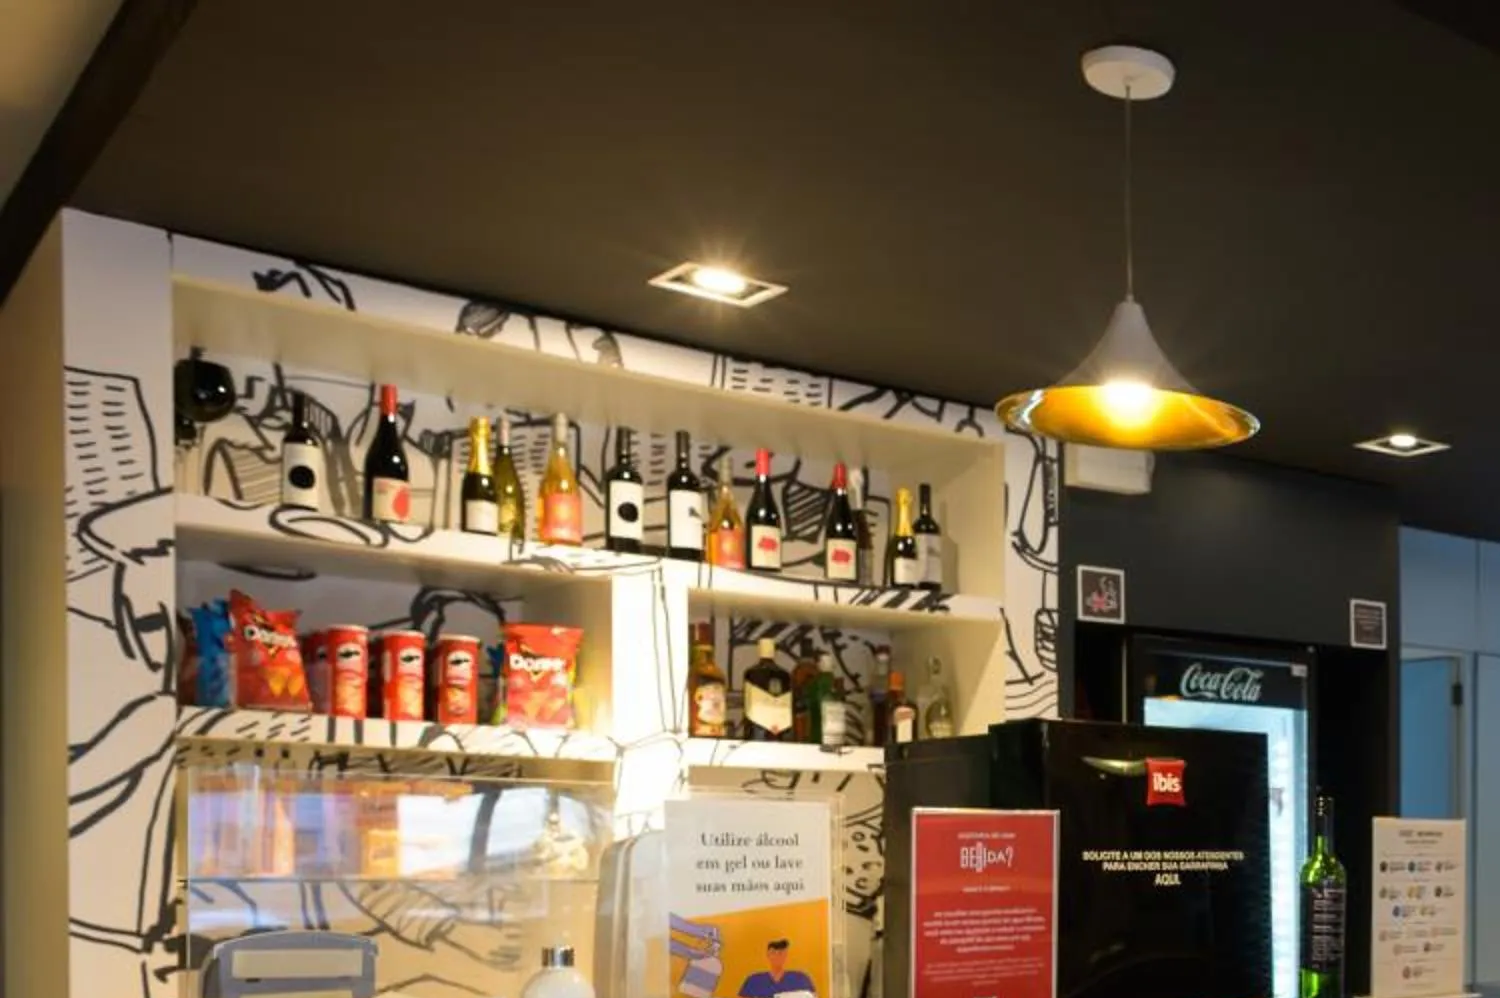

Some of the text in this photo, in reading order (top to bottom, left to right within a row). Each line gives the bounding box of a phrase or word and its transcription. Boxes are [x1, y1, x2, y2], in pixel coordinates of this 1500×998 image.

[1152, 771, 1182, 793] ibis
[700, 831, 800, 848] Utilize álcool
[696, 855, 804, 874] em gel ou lave
[1082, 851, 1121, 861] SOLICITE
[1130, 851, 1142, 861] UM
[1144, 851, 1158, 861] DOS
[1163, 851, 1194, 861] NOSSOS
[1195, 851, 1245, 861] ATENDENTES
[1102, 861, 1125, 871] PARA
[1128, 861, 1160, 871] ENCHER
[1162, 861, 1178, 871] SUA
[696, 877, 805, 895] suas mãos aqui
